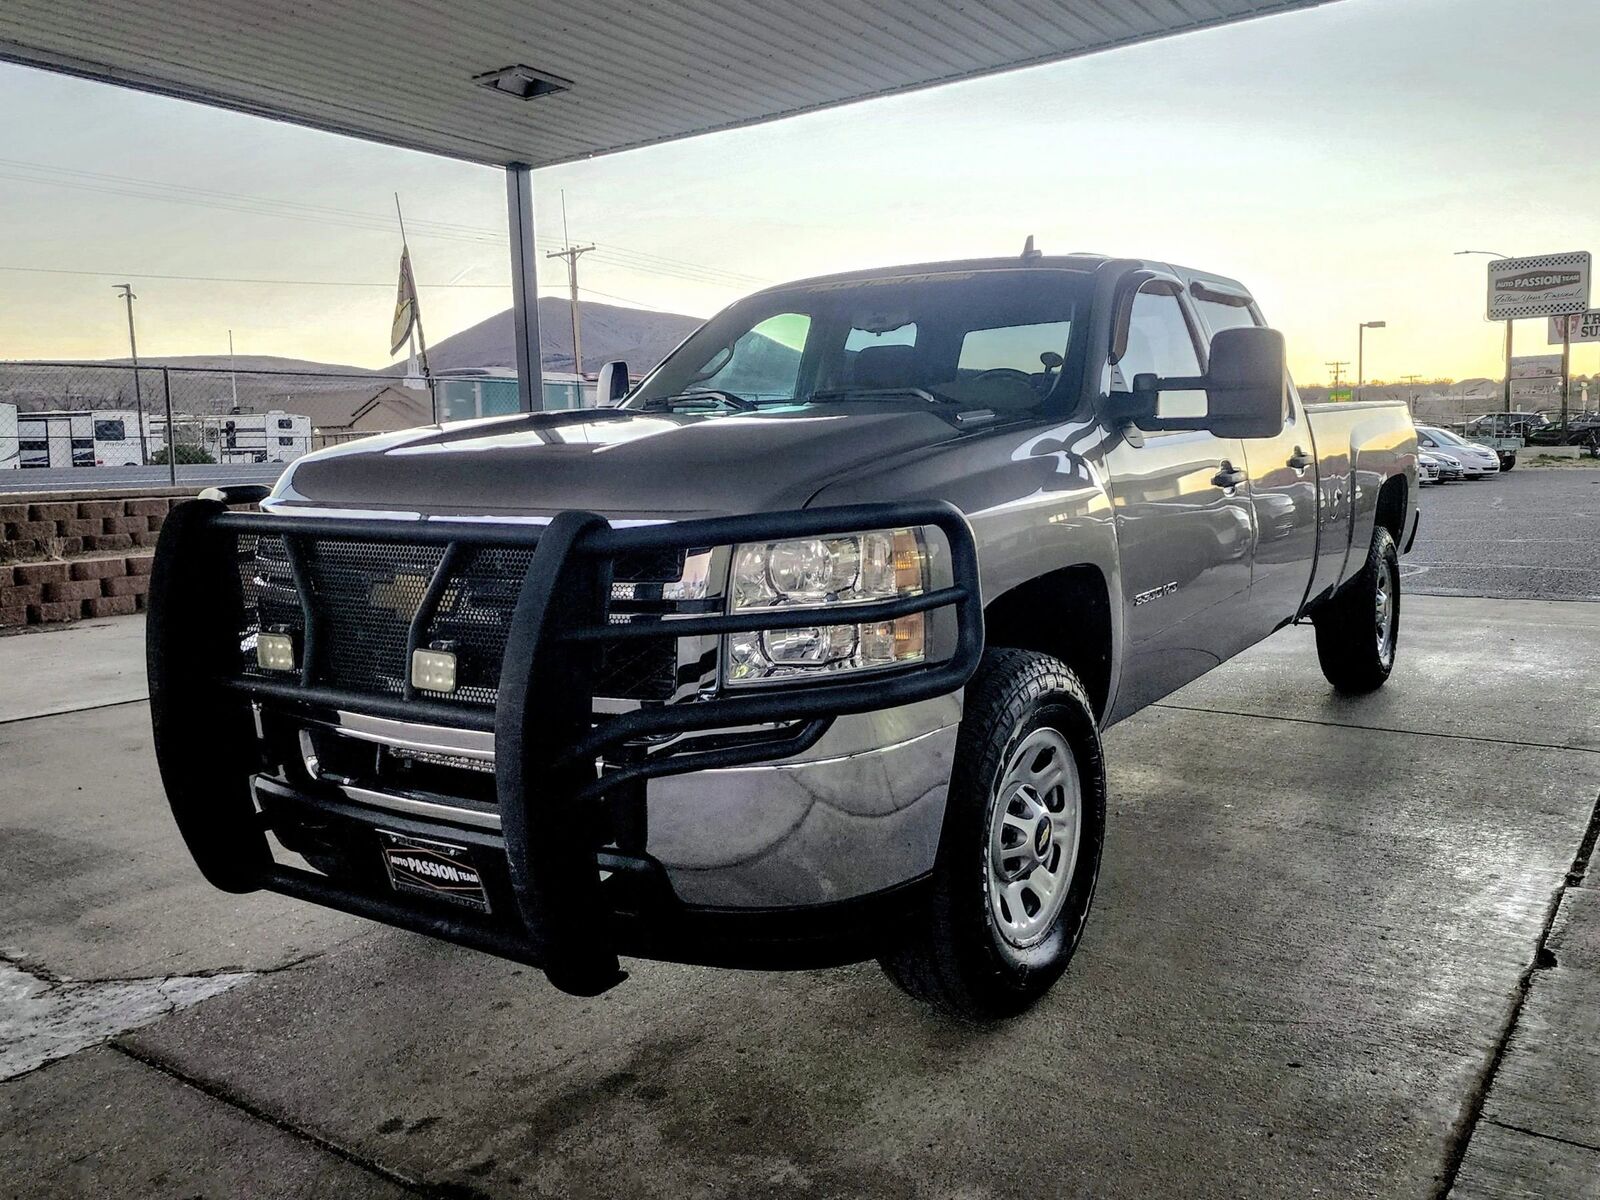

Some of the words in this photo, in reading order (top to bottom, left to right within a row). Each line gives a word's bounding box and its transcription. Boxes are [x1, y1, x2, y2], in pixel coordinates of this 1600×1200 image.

[1514, 275, 1561, 288] PASSION
[1561, 274, 1580, 282] TEAM
[1580, 325, 1600, 337] SU
[390, 855, 409, 867] AUTO
[407, 857, 459, 882] PASSION
[458, 871, 479, 883] TEAM
